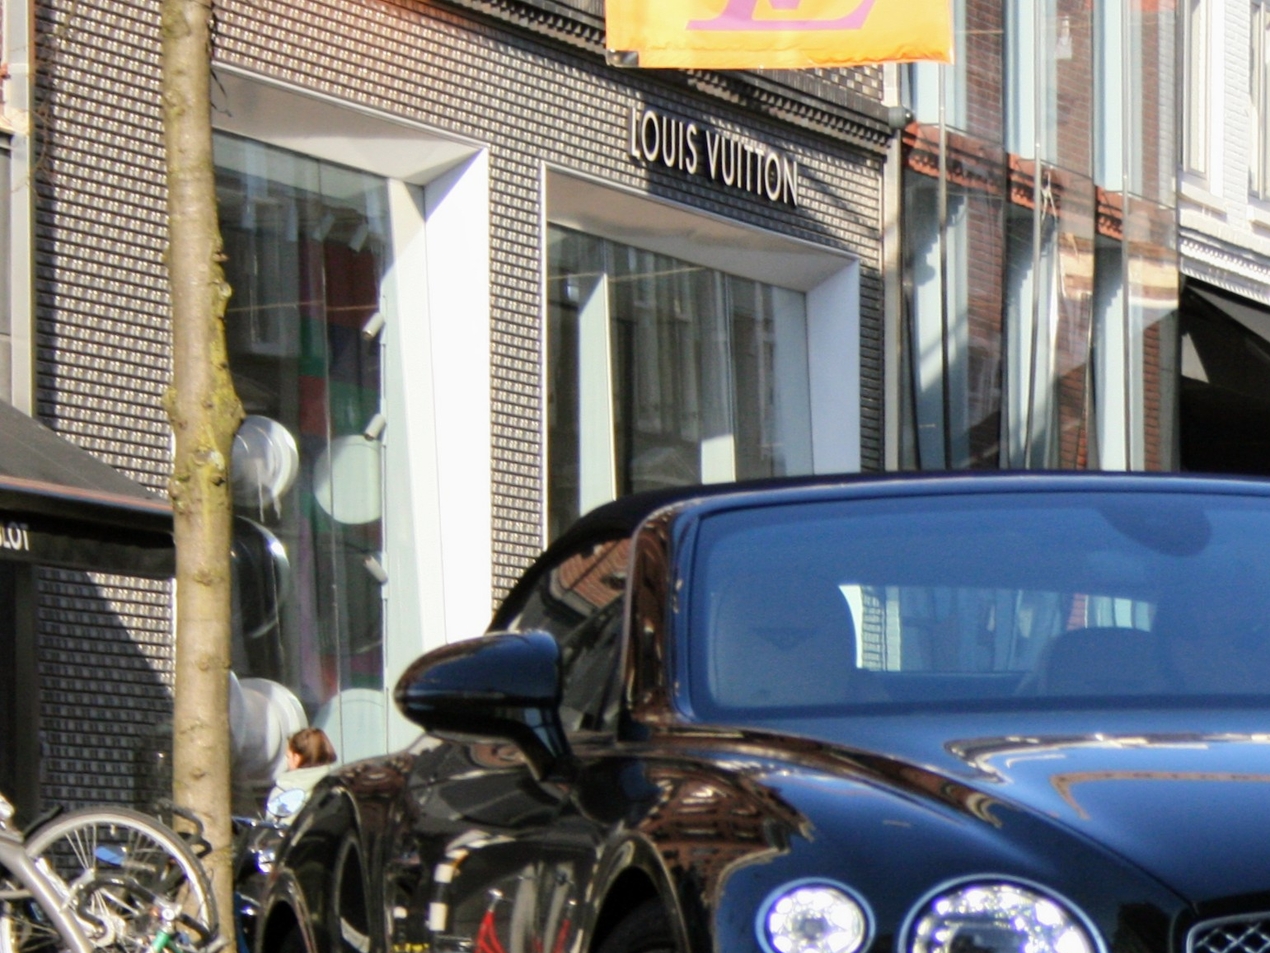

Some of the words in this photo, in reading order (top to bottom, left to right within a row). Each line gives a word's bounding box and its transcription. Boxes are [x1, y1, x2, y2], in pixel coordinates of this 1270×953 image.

[630, 106, 699, 176] LOUIS
[705, 130, 799, 207] VUITTON
[0, 522, 30, 552] LOT
